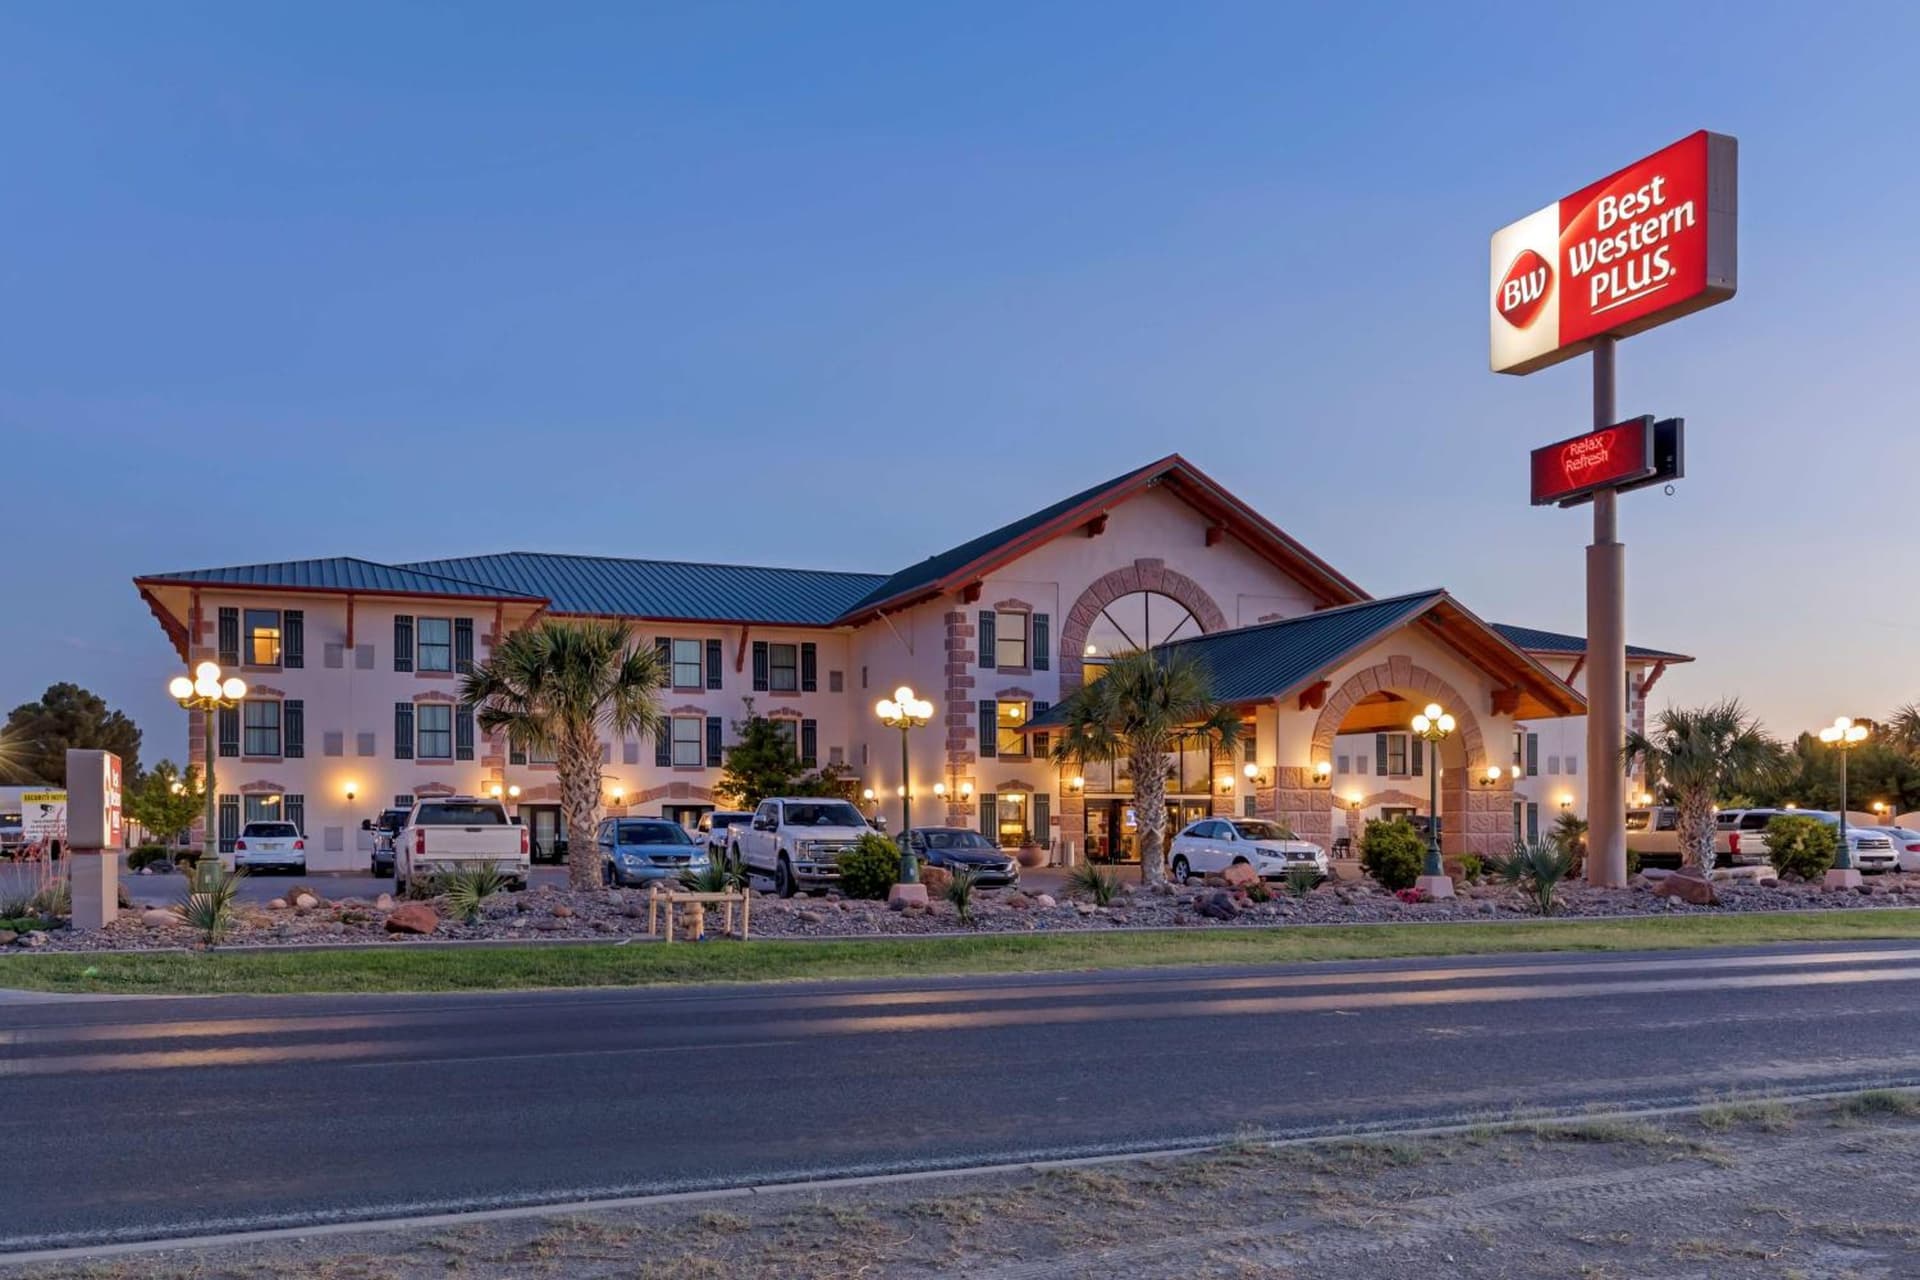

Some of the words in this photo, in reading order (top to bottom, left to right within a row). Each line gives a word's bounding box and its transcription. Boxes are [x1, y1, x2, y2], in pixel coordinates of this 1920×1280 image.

[1597, 175, 1666, 233] Best
[1568, 200, 1696, 278] Western
[1504, 267, 1546, 312] BW
[1565, 450, 1609, 472] Refresh
[1570, 436, 1604, 456] Relax
